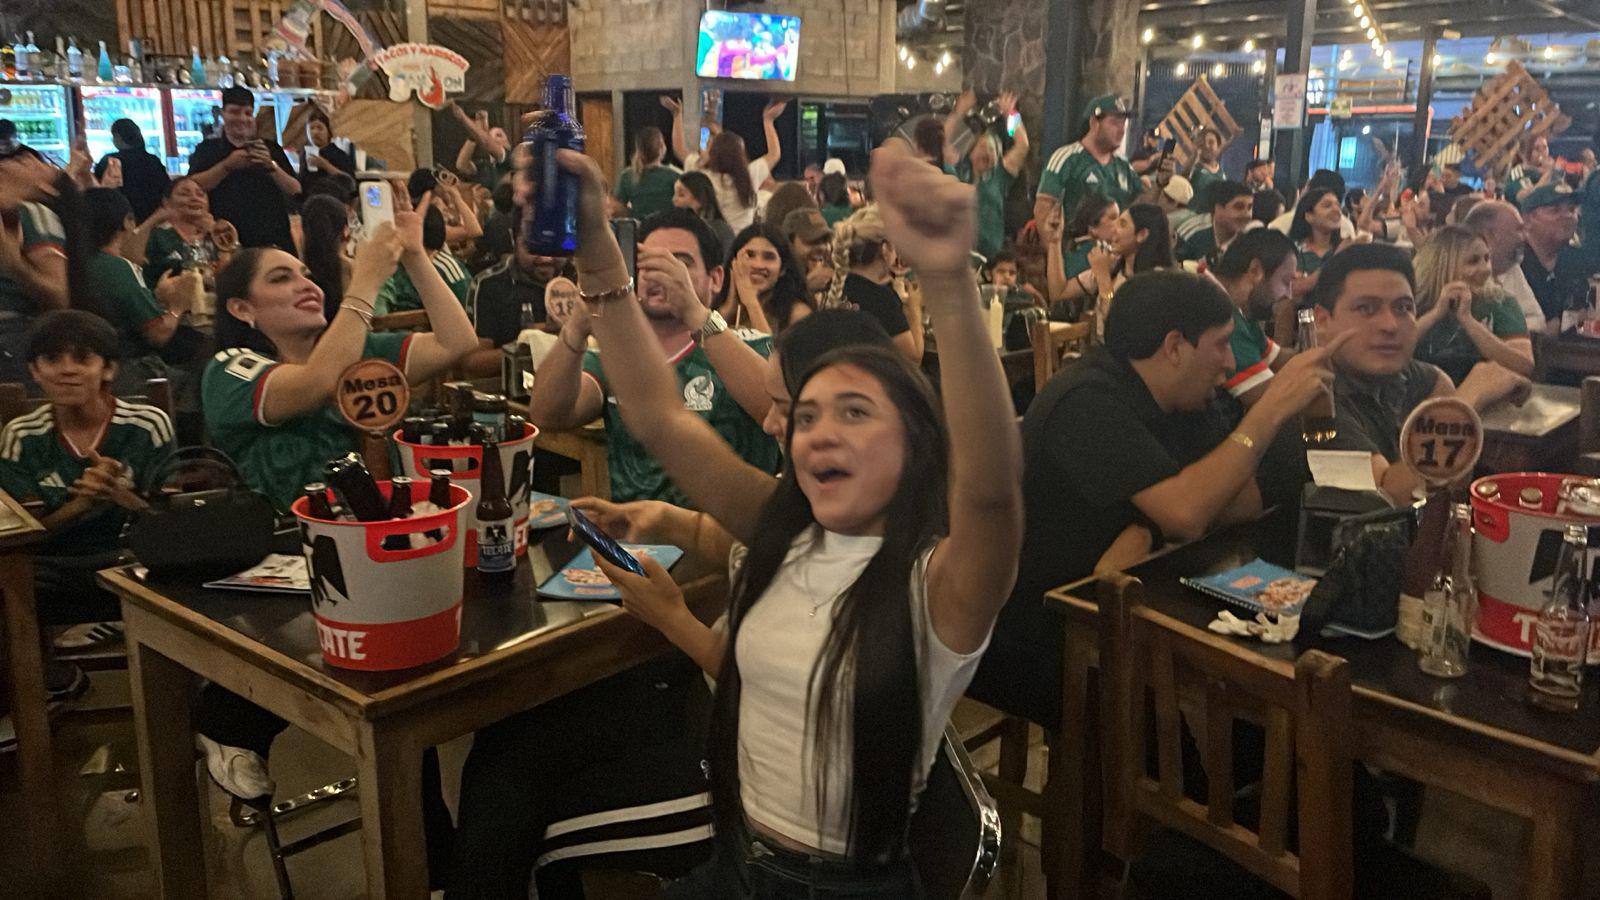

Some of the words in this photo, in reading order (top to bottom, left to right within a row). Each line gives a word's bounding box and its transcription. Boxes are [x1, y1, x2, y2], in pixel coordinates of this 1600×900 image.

[343, 374, 401, 393] Mesa
[352, 390, 397, 420] 20
[1414, 415, 1476, 436] Mesa
[1416, 439, 1465, 467] 17
